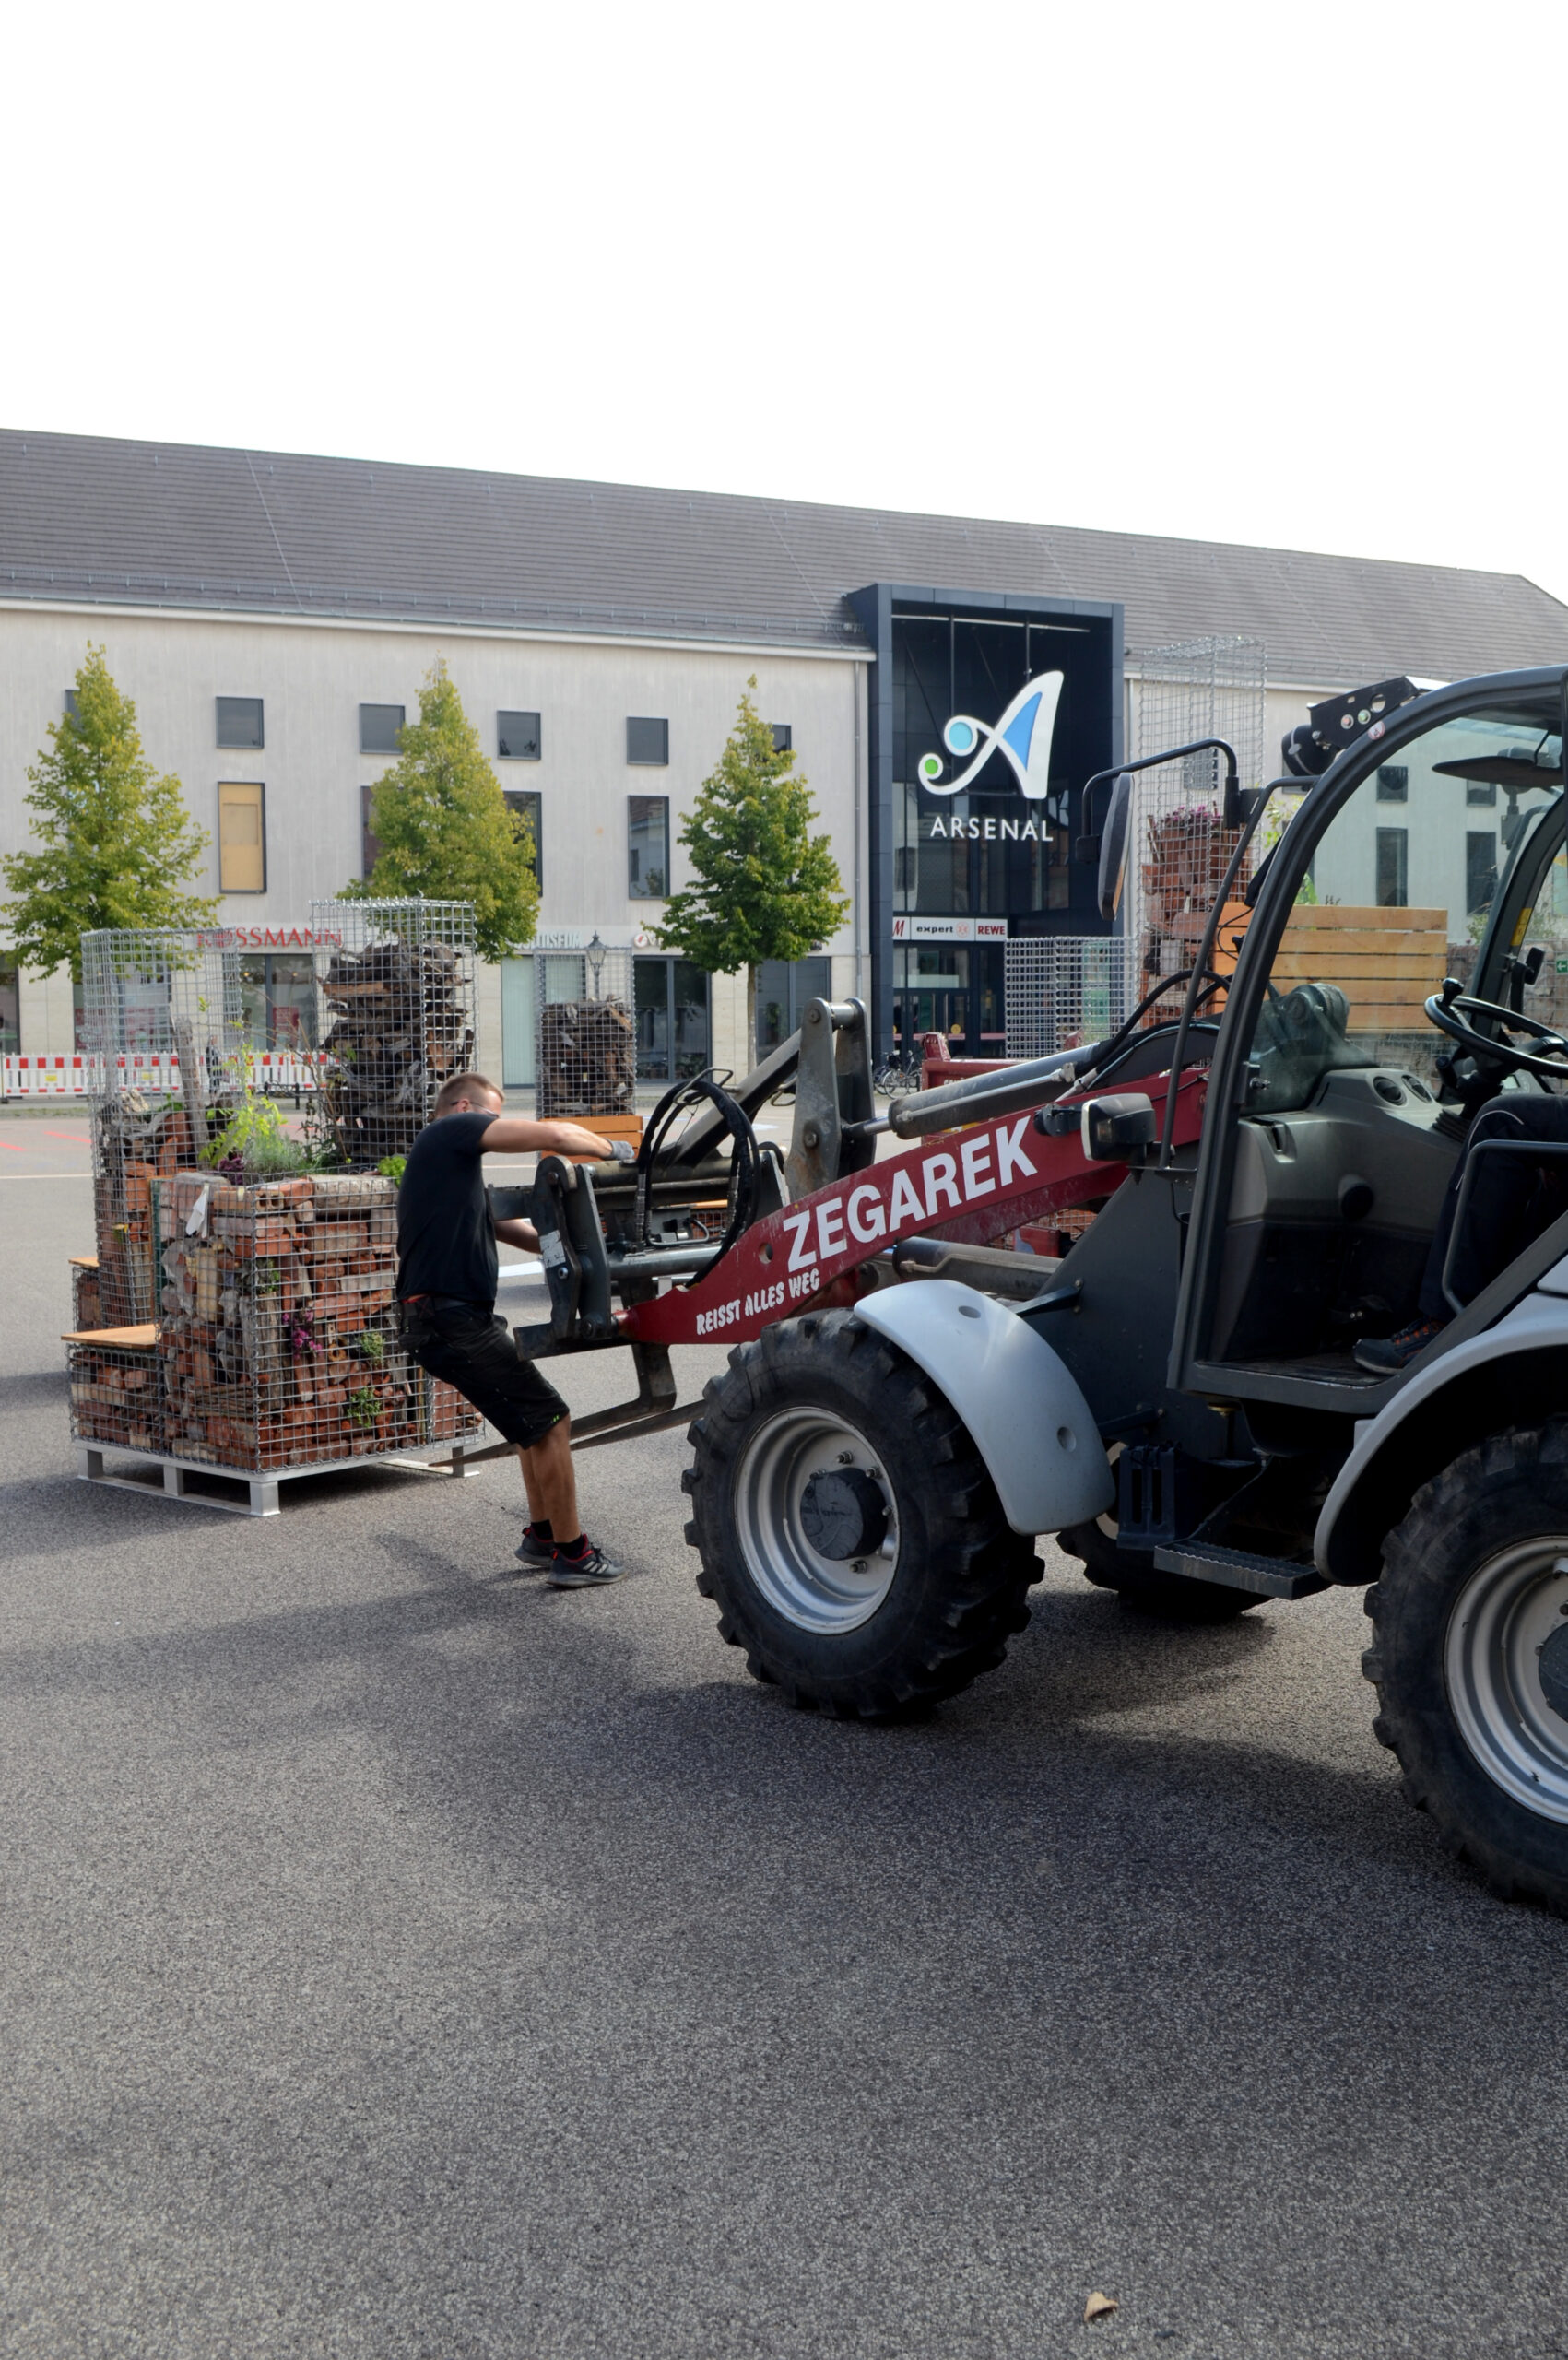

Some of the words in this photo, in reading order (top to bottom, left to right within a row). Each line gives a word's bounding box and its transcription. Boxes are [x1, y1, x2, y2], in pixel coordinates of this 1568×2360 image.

[929, 816, 1054, 842] ARSENAL
[916, 926, 954, 934] expert
[977, 926, 1006, 936] REWE
[783, 1115, 1038, 1273] ZEGAREK
[696, 1298, 741, 1335] REISST
[744, 1281, 785, 1316] ALLES
[788, 1268, 820, 1298] WEG
